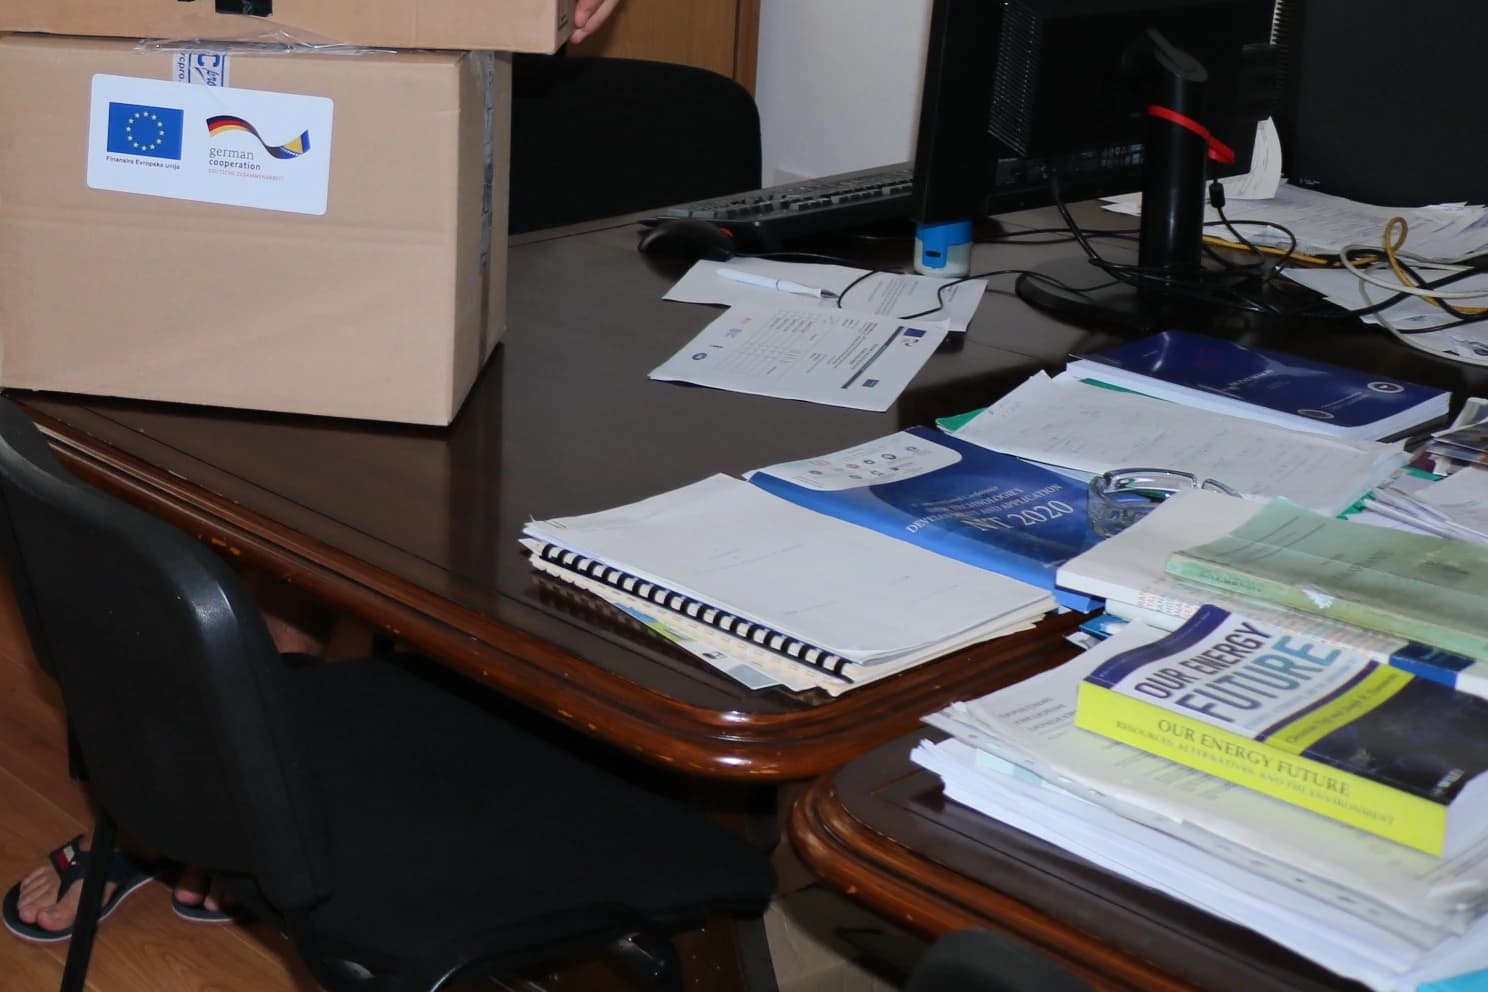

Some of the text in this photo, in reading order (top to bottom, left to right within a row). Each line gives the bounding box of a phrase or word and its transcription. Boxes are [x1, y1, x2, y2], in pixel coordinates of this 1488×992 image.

[208, 158, 261, 172] cooperation
[209, 146, 254, 161] german
[1007, 499, 1075, 527] 2020
[1133, 668, 1200, 700] OUR
[1179, 621, 1272, 676] ENERGY
[1174, 635, 1343, 724] FUTURE
[1157, 719, 1351, 797] OUR ENERGY FUTURE
